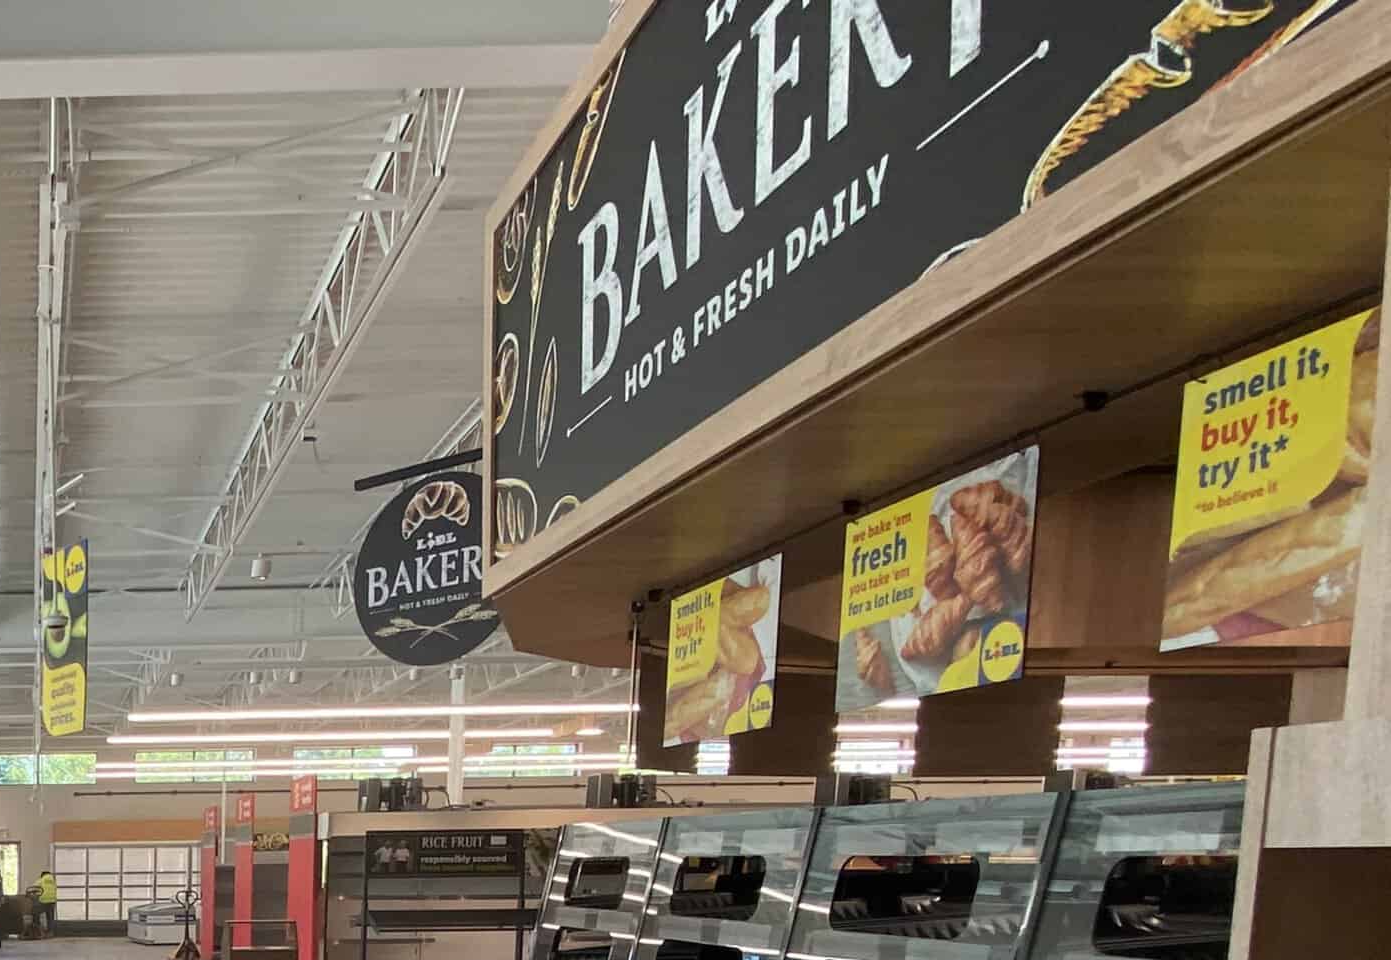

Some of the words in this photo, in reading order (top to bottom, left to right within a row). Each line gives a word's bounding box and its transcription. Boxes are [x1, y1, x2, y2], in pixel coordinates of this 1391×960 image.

[624, 339, 666, 402] HOT
[671, 326, 686, 365] &
[693, 247, 775, 347] FRESH
[785, 153, 889, 275] DAILY
[1203, 356, 1287, 415] smell
[1296, 346, 1330, 380] it,
[1200, 411, 1259, 452] buy
[1266, 396, 1299, 430] it,
[1198, 456, 1240, 489] try
[1216, 484, 1265, 510] believe
[1267, 480, 1279, 496] it
[852, 530, 866, 545] we
[868, 519, 892, 539] bake
[851, 532, 907, 577] fresh
[365, 545, 483, 608] BAKER
[849, 582, 868, 598] you
[869, 573, 890, 590] take
[676, 595, 703, 620] smell
[848, 601, 863, 617] for
[874, 591, 890, 610] lot
[892, 586, 914, 606] less
[675, 623, 695, 641] buy
[674, 643, 689, 661] try
[422, 836, 447, 849] RICE
[451, 835, 482, 848] FRUIT
